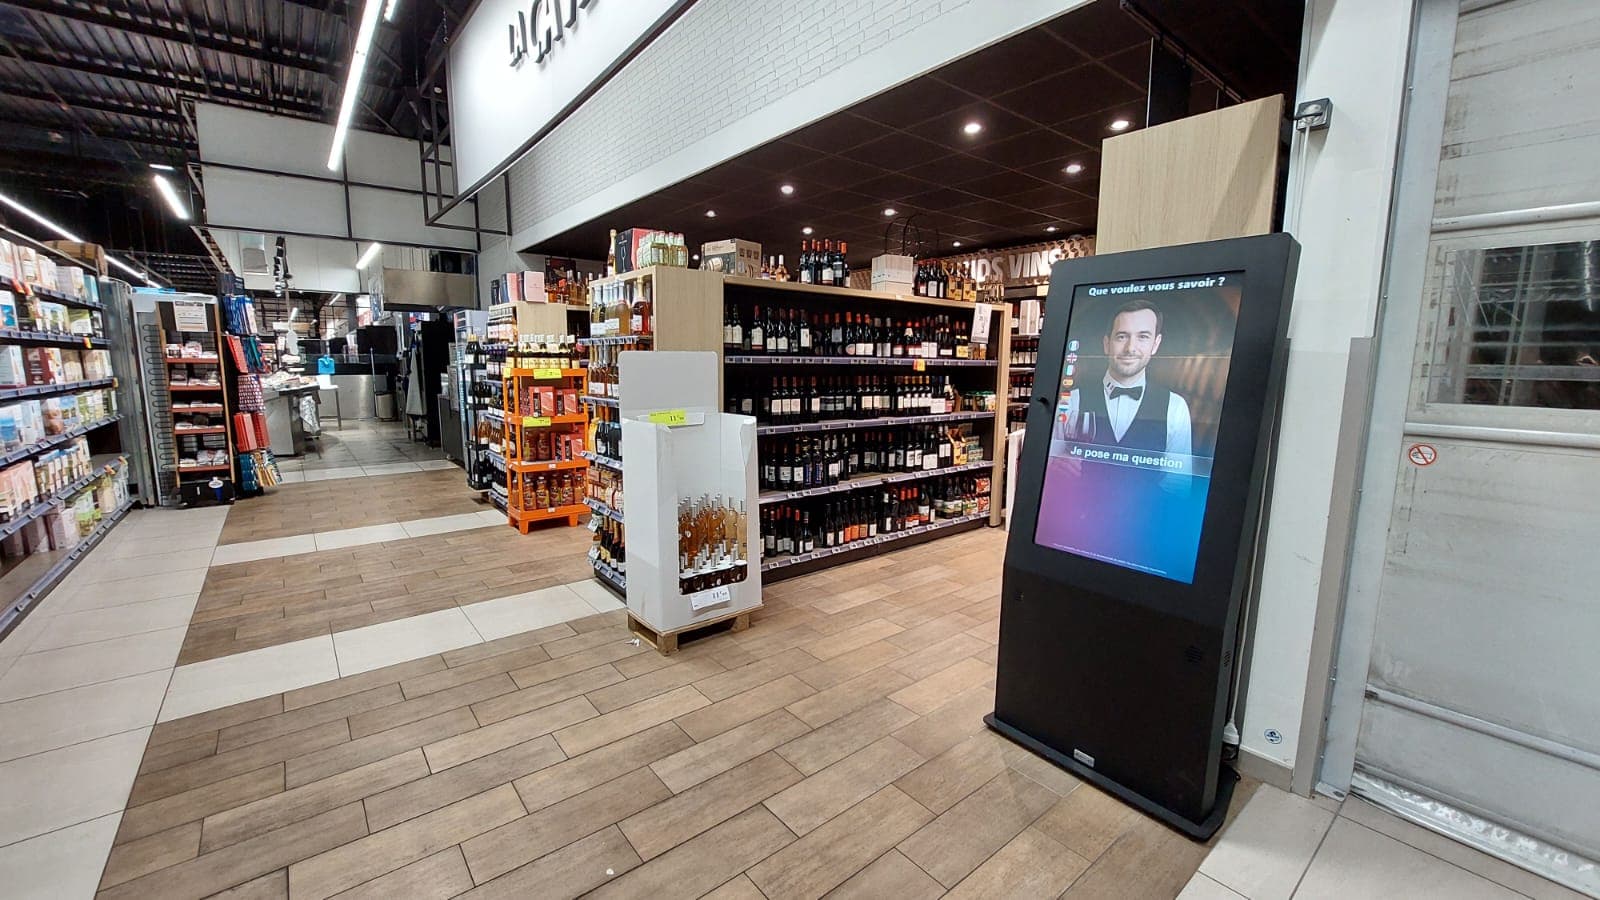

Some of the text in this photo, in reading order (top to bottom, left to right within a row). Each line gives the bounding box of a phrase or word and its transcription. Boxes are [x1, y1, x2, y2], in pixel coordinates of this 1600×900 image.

[1088, 276, 1226, 296] Que voulez vous savoir ?
[1070, 446, 1183, 469] Je pose ma question
